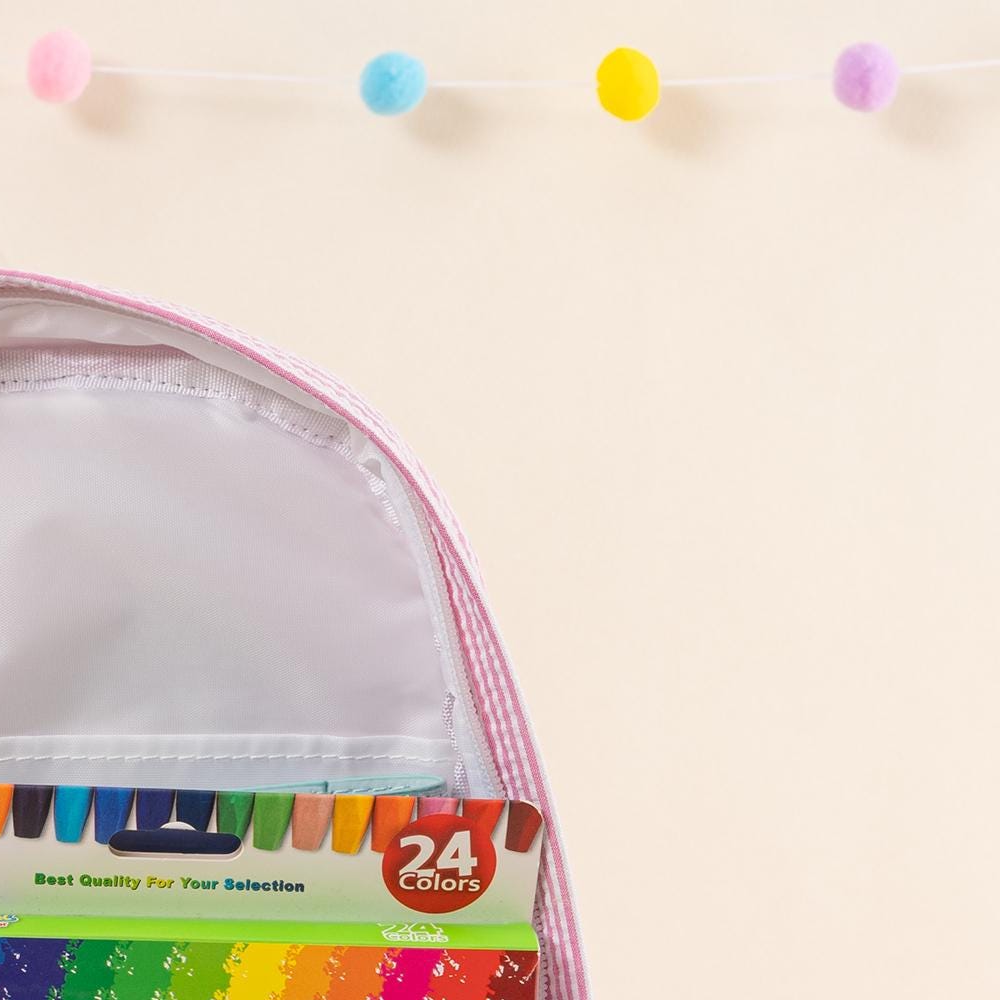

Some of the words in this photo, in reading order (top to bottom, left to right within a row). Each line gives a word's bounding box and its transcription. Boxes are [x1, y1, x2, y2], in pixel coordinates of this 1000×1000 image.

[399, 830, 478, 877] 24
[34, 872, 74, 886] Best
[79, 874, 142, 890] Quality
[146, 876, 175, 888] For
[180, 876, 219, 889] Your
[223, 878, 305, 893] Selection
[398, 872, 481, 892] Colors
[382, 931, 449, 943] Colors
